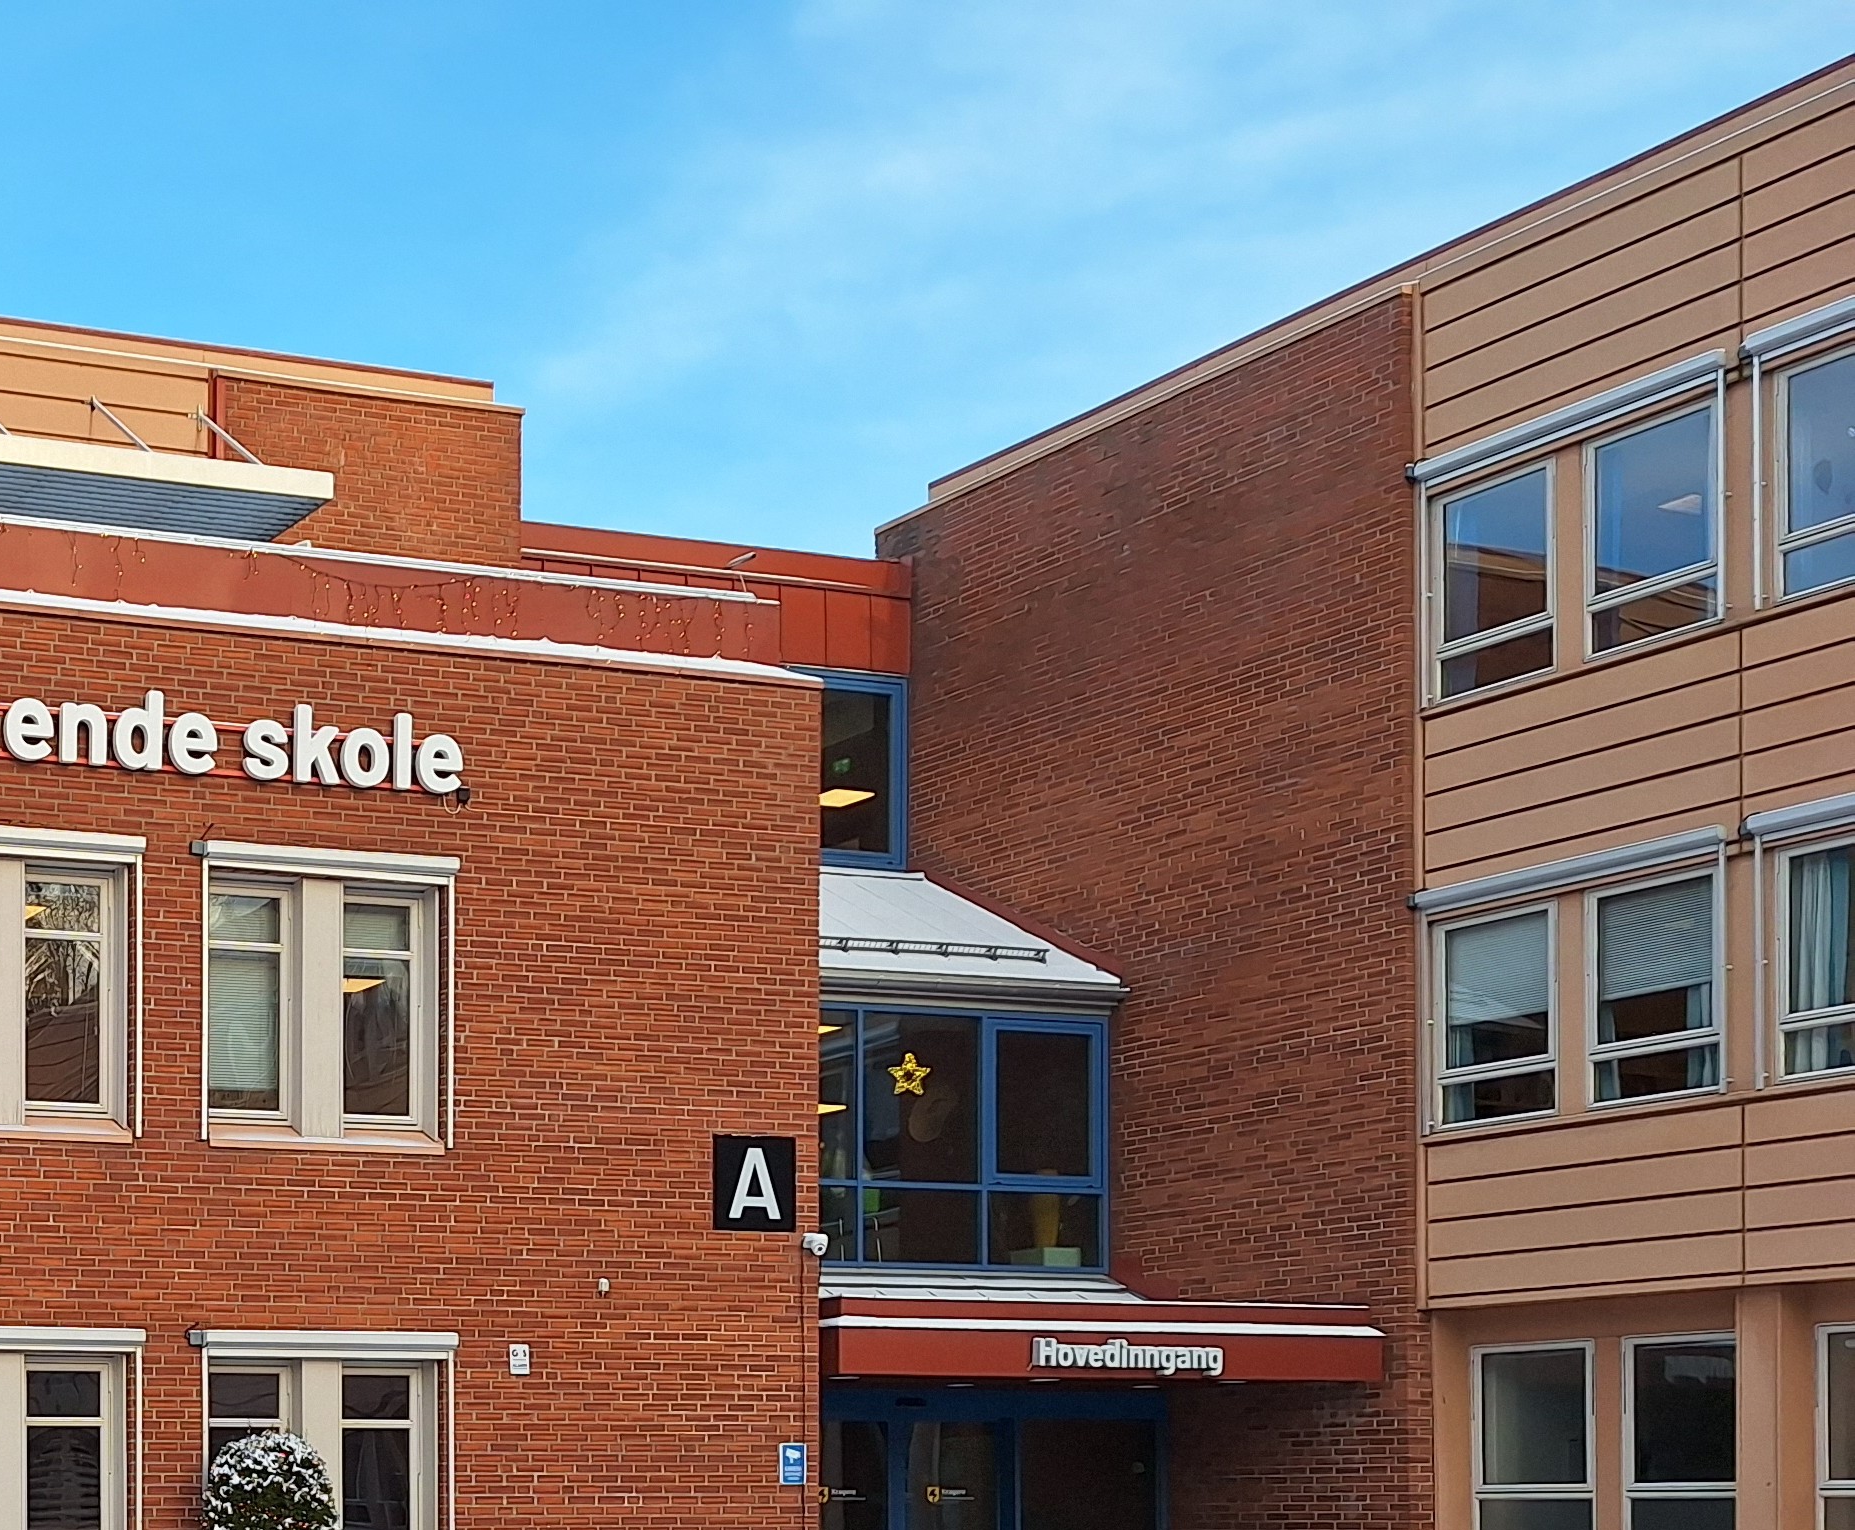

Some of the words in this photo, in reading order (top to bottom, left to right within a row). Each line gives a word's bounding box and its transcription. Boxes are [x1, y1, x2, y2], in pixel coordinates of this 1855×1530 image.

[242, 703, 465, 794] skole
[728, 1147, 782, 1220] A
[1032, 1337, 1223, 1376] Hovedinngang
